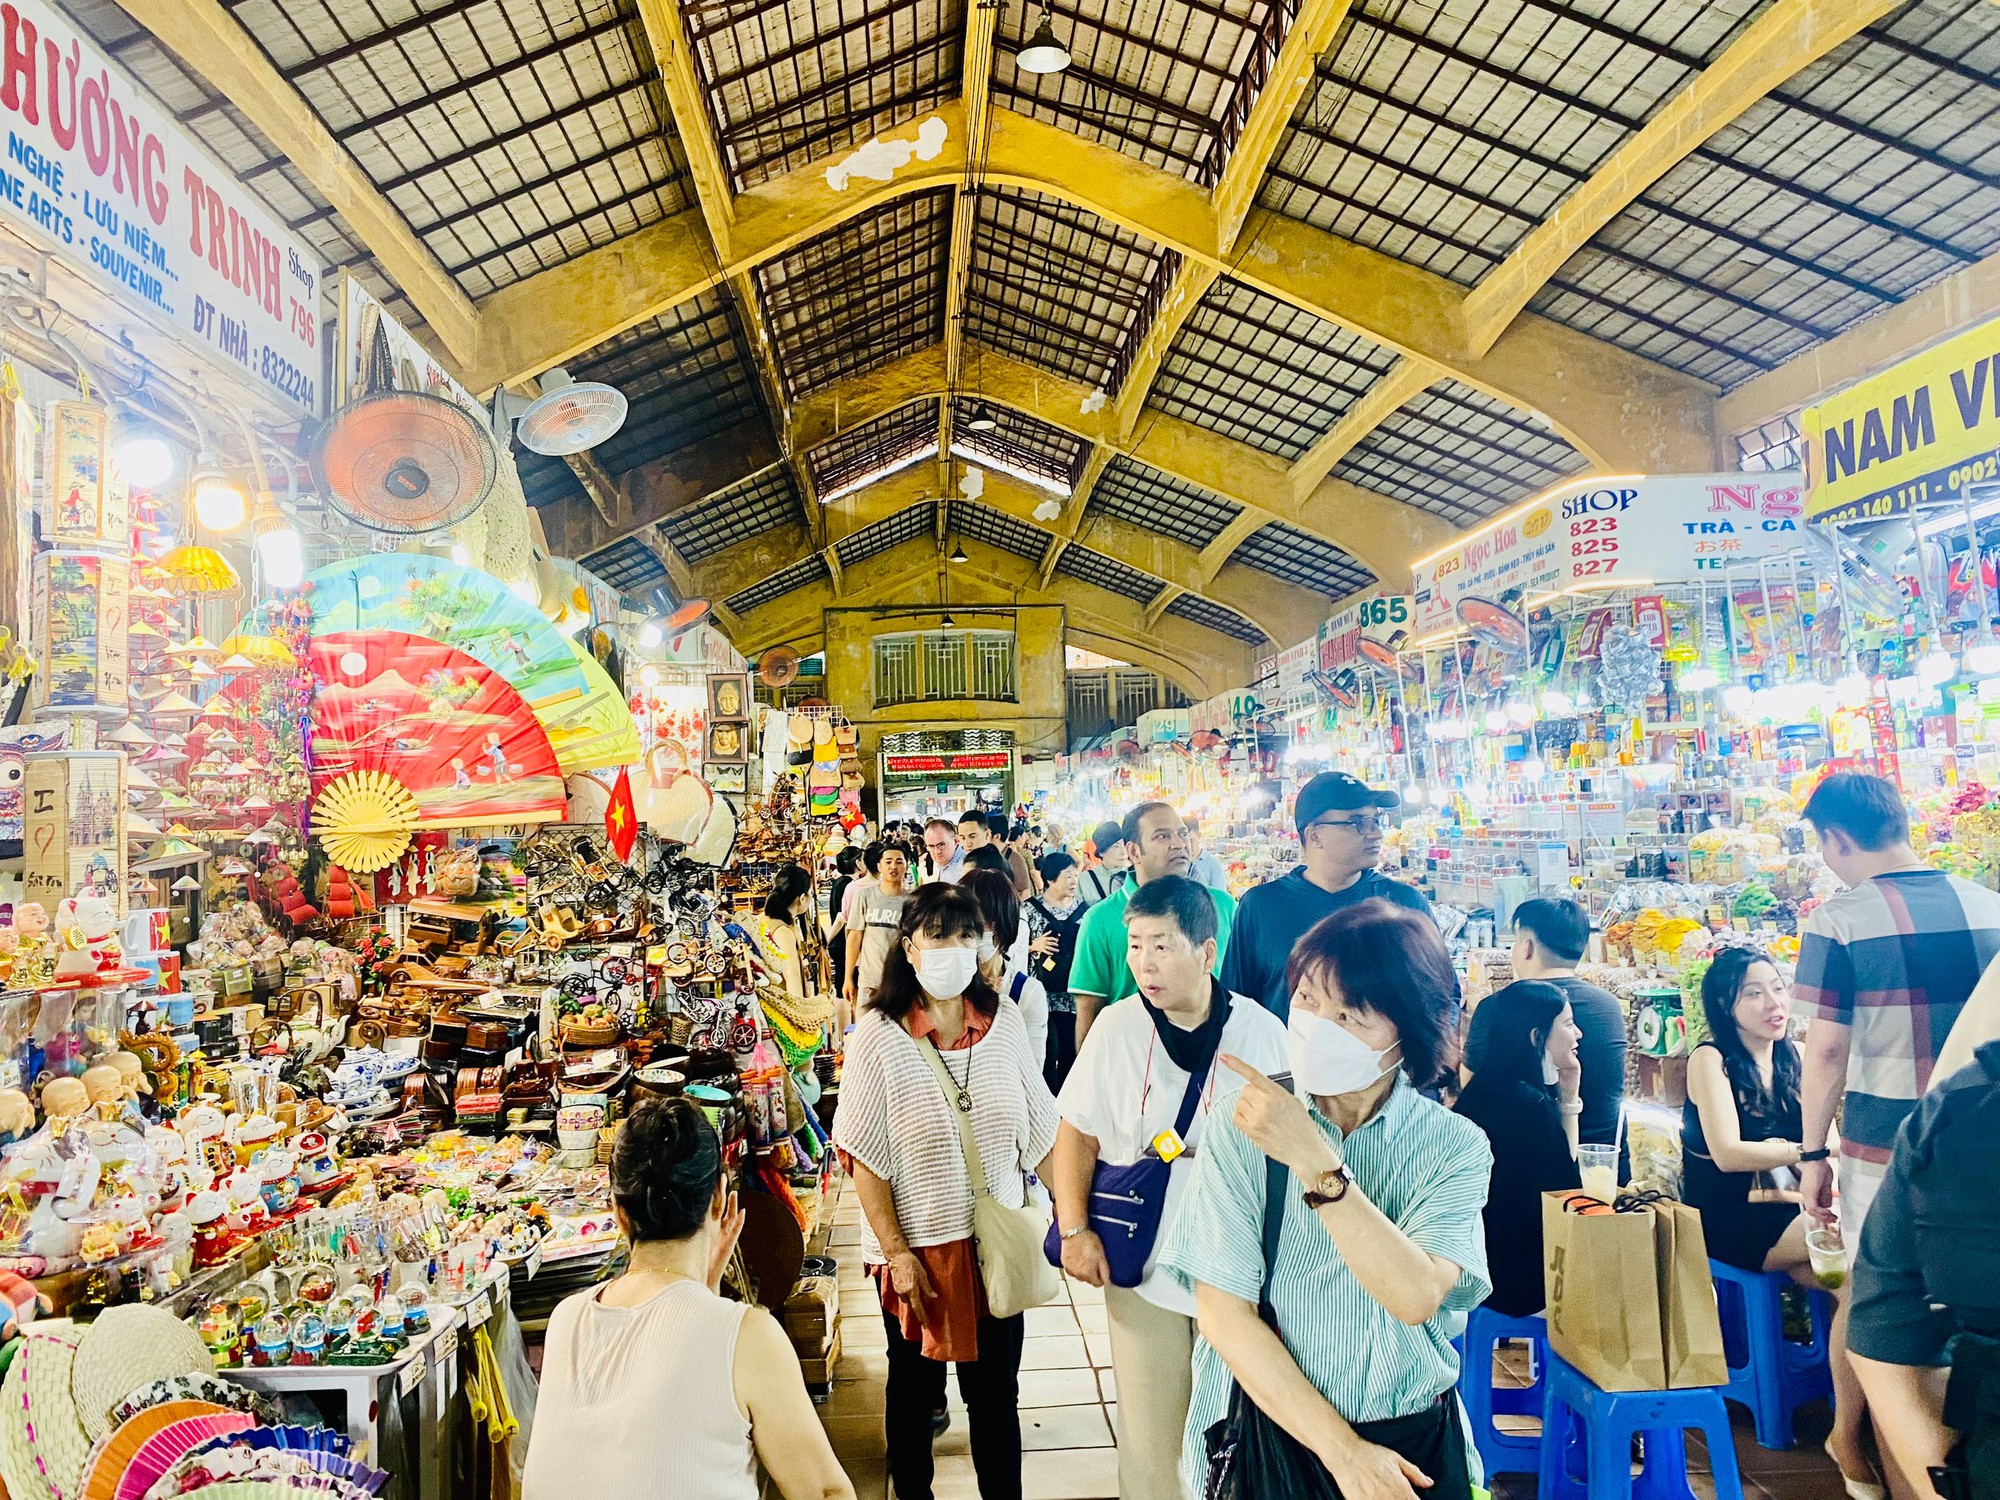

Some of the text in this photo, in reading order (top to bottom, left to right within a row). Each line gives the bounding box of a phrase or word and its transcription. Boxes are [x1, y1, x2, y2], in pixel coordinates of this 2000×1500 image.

[0, 3, 282, 322] HƯƠNG TRINH
[8, 130, 64, 203] NGHỆ
[84, 189, 118, 236] LƯU
[28, 191, 73, 244] ARTS
[289, 247, 314, 300] Shop
[290, 296, 314, 349] 796
[194, 294, 314, 411] ĐT NHÀ 8322244
[1825, 385, 1936, 484] NAM
[1863, 495, 1892, 517] 140
[1949, 456, 1997, 490] 0902
[1562, 489, 1638, 519] SHOP
[1570, 517, 1617, 537] 823
[1683, 517, 1796, 534] TRÀ CÀ
[1464, 527, 1517, 573] Ngọc Hoa
[1571, 538, 1618, 557] 825
[1694, 539, 1741, 553] お茶
[1438, 557, 1460, 577] 823
[1572, 559, 1618, 577] 827
[1693, 558, 1724, 570] TE
[1360, 597, 1408, 628] 865
[34, 790, 55, 814] I
